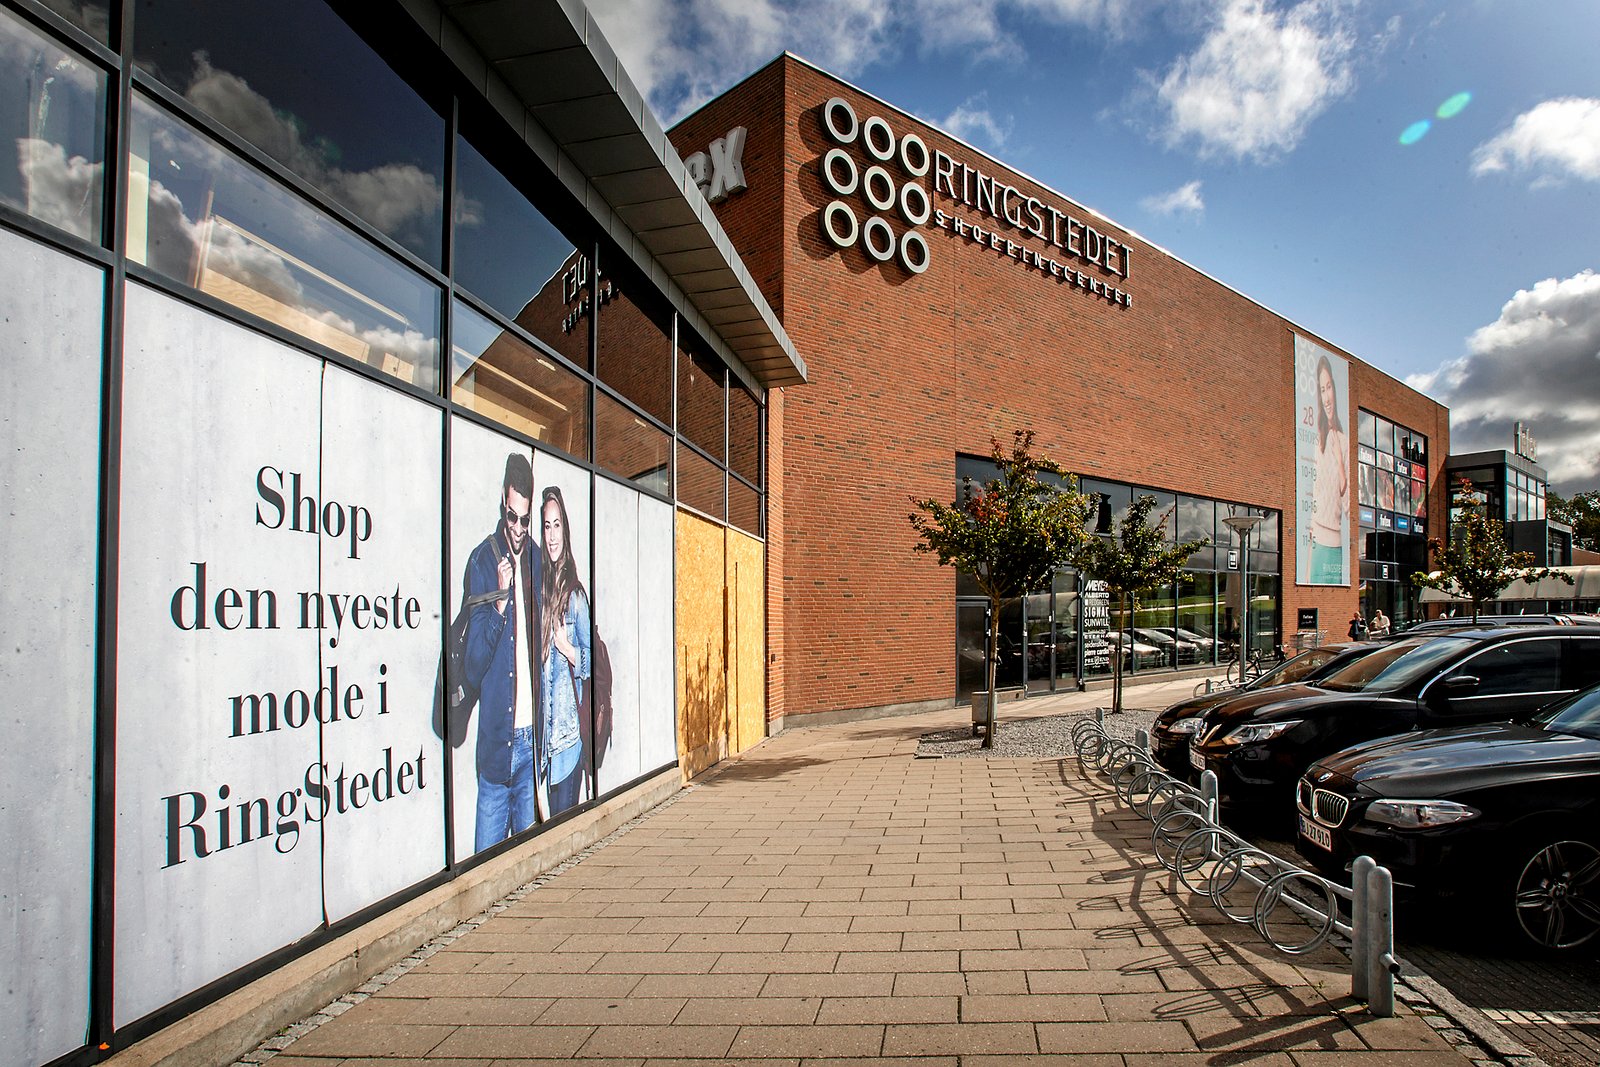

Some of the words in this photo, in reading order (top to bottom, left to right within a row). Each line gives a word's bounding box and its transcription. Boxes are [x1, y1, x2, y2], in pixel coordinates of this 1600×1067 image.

[678, 126, 747, 203] ex
[935, 149, 1134, 279] RINGSTEDET
[934, 209, 1133, 307] SHOPPINGCENTER
[1298, 428, 1319, 446] SHOPS
[1303, 406, 1315, 427] 28
[255, 466, 373, 560] Shop
[1302, 465, 1317, 481] 10-19
[170, 561, 281, 631] den
[297, 582, 422, 648] nyeste
[227, 664, 365, 739] mode
[377, 663, 390, 715] i
[160, 744, 428, 870] RingStedet
